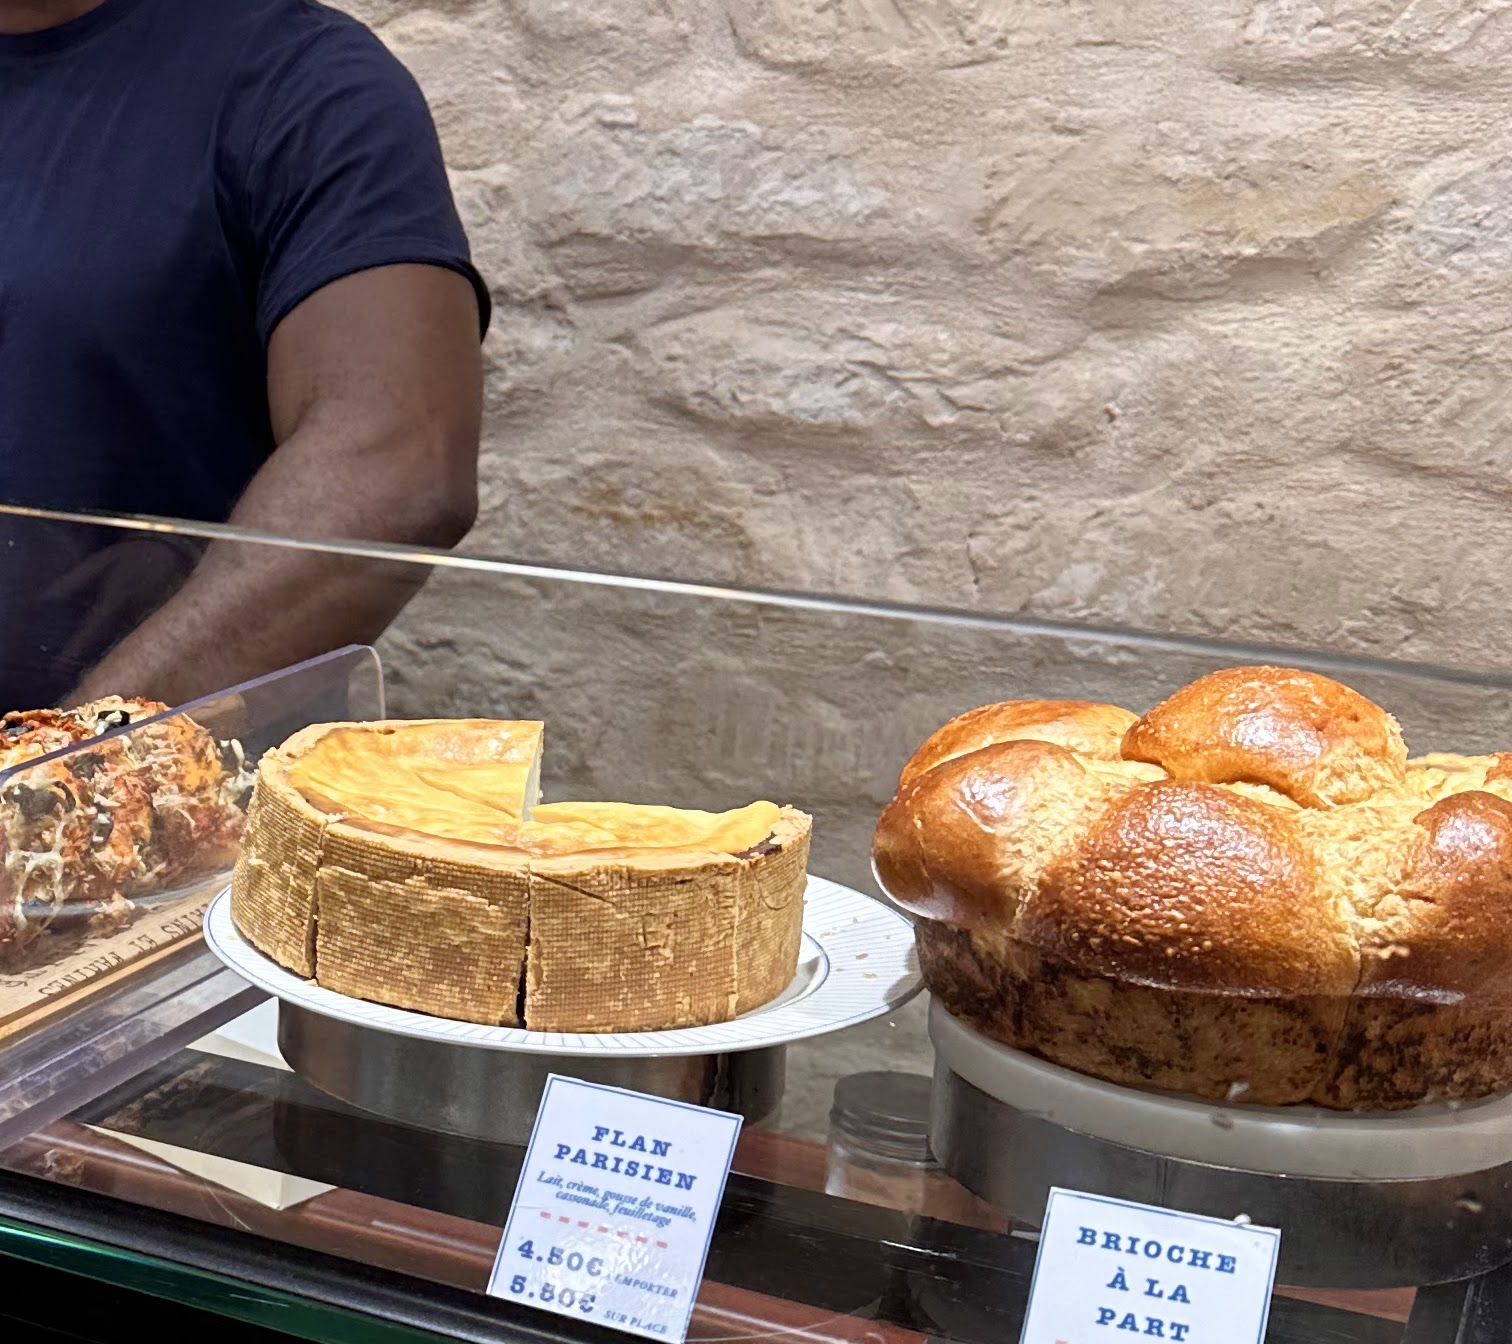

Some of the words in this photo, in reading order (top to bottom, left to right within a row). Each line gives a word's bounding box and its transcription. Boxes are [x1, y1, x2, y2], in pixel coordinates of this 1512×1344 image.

[592, 1125, 672, 1158] FLAN
[554, 1144, 697, 1191] PARISIEN
[537, 1171, 565, 1188] Lait,
[566, 1178, 600, 1198] crème,
[603, 1189, 638, 1205] gousse
[639, 1196, 654, 1208] de
[655, 1200, 697, 1223] vanille,
[518, 1240, 604, 1277] 4.50€
[1077, 1226, 1237, 1274] BRIOCHE
[510, 1275, 596, 1313] 5.50€
[1106, 1266, 1129, 1291] À
[1144, 1278, 1191, 1304] LA
[1095, 1307, 1190, 1342] PART
